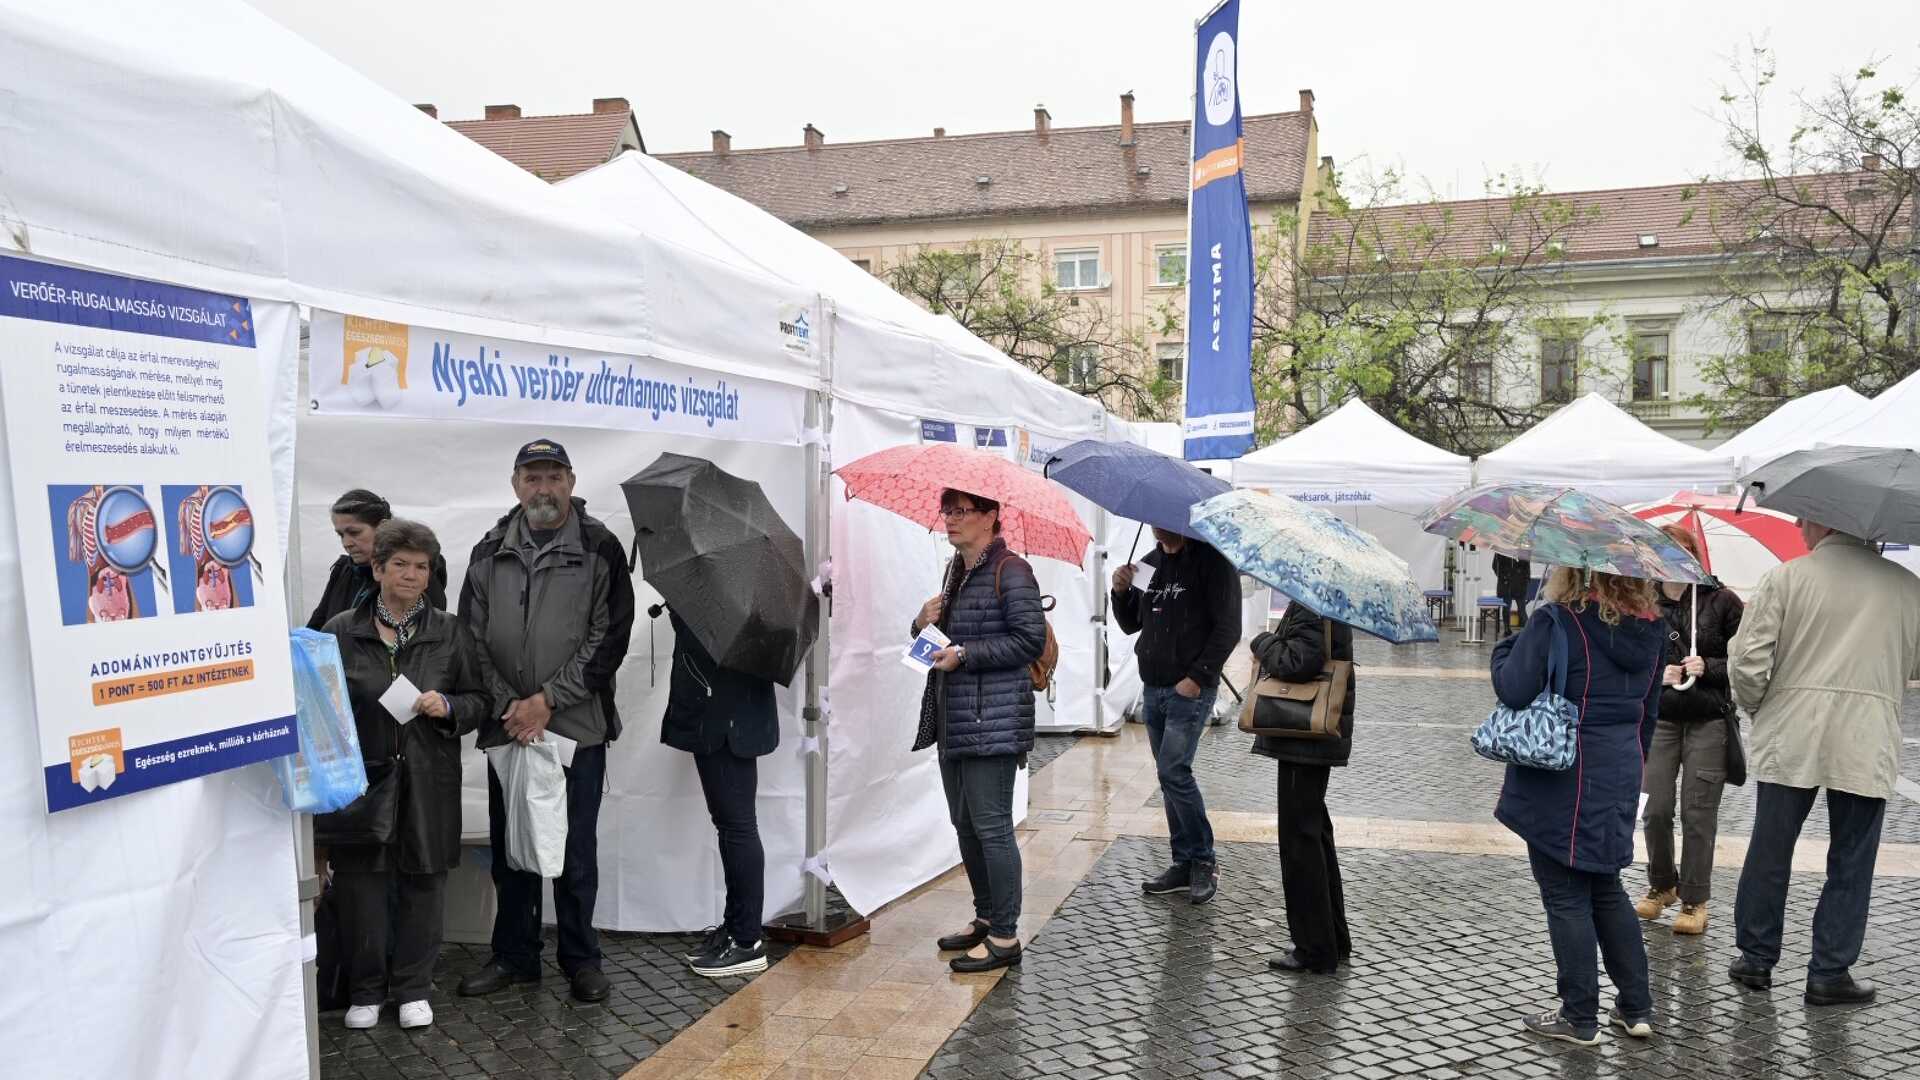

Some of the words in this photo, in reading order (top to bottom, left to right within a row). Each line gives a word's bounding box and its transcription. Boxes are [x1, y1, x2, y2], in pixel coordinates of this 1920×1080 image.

[10, 280, 166, 318] VERŐÉR-RUGALMASSÁG
[168, 306, 226, 328] VIZSGÁLAT
[1210, 242, 1222, 352] ASZTMA
[55, 341, 62, 352] A
[64, 344, 104, 358] vizsgálat
[106, 346, 126, 361] célja
[128, 352, 138, 361] az
[139, 350, 159, 363] érfal
[56, 363, 138, 381] rugalmasságának
[206, 376, 223, 390] még
[59, 384, 65, 393] a
[66, 381, 100, 395] tünetek
[103, 386, 156, 399] jelentkezése
[432, 341, 508, 407] Nyaki
[511, 354, 584, 402] verőér
[585, 360, 677, 421] ultrahangos
[681, 377, 739, 428] vizsgálat
[61, 402, 72, 413] az
[75, 400, 97, 414] érfal
[163, 407, 169, 418] A
[172, 408, 198, 420] mérés
[137, 424, 159, 439] hogy
[164, 426, 192, 440] milyen
[65, 440, 138, 454] érelmeszesedés
[140, 443, 168, 455] alakult
[90, 641, 253, 677] ADOMÁNYPONTGYŰJTÉS
[100, 688, 105, 699] 1
[108, 682, 135, 698] PONT
[147, 680, 165, 692] 500
[167, 676, 179, 689] FT
[182, 673, 194, 685] AZ
[196, 665, 250, 683] INTÉZETNEK
[135, 749, 176, 769] Egészség
[177, 742, 217, 760] ezreknek,
[219, 734, 245, 750] milliók
[253, 725, 290, 742] kórháznak
